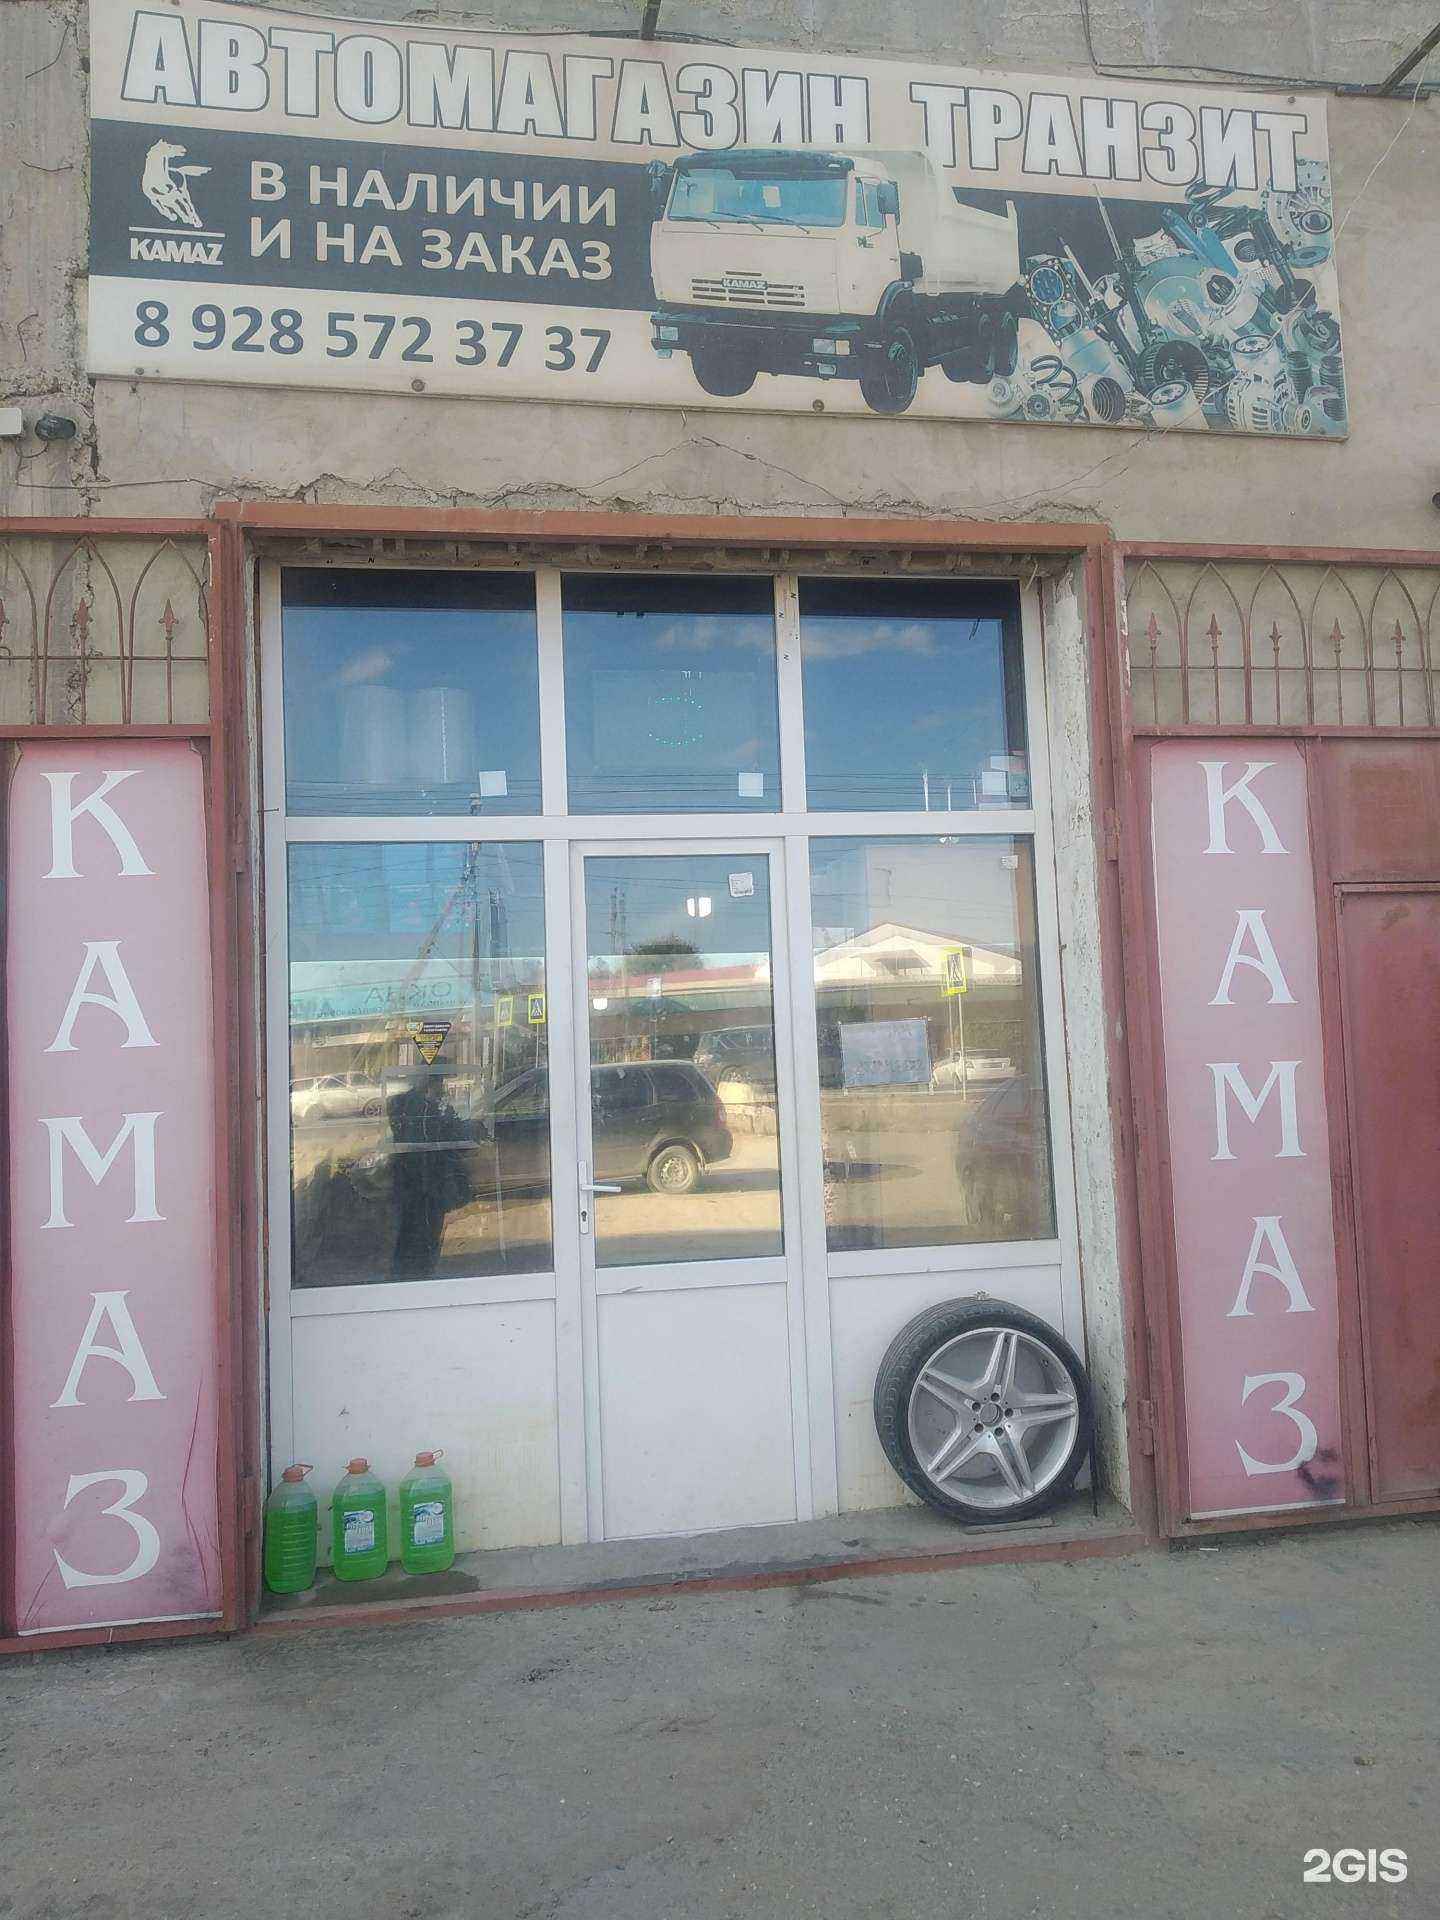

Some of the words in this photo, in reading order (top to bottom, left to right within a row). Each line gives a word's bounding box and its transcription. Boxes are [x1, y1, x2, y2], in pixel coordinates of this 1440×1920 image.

[120, 11, 871, 150] АВТОМАГАЗИН
[909, 82, 1308, 194] ТРАНЗИТ
[250, 160, 287, 202] В
[309, 165, 616, 227] НАЛИЧИИ
[130, 237, 224, 266] KAMAZ
[250, 216, 291, 259] И
[317, 221, 402, 268] НА
[421, 228, 613, 281] ЗАКАЗ
[721, 279, 767, 289] KAMAZ
[133, 300, 171, 349] 8
[191, 303, 304, 356] 928
[326, 311, 434, 364] 572
[454, 319, 524, 368] 37
[545, 326, 611, 373] 37
[1198, 761, 1318, 1478] КАМАЗ
[38, 769, 166, 1591] КАМАЗ
